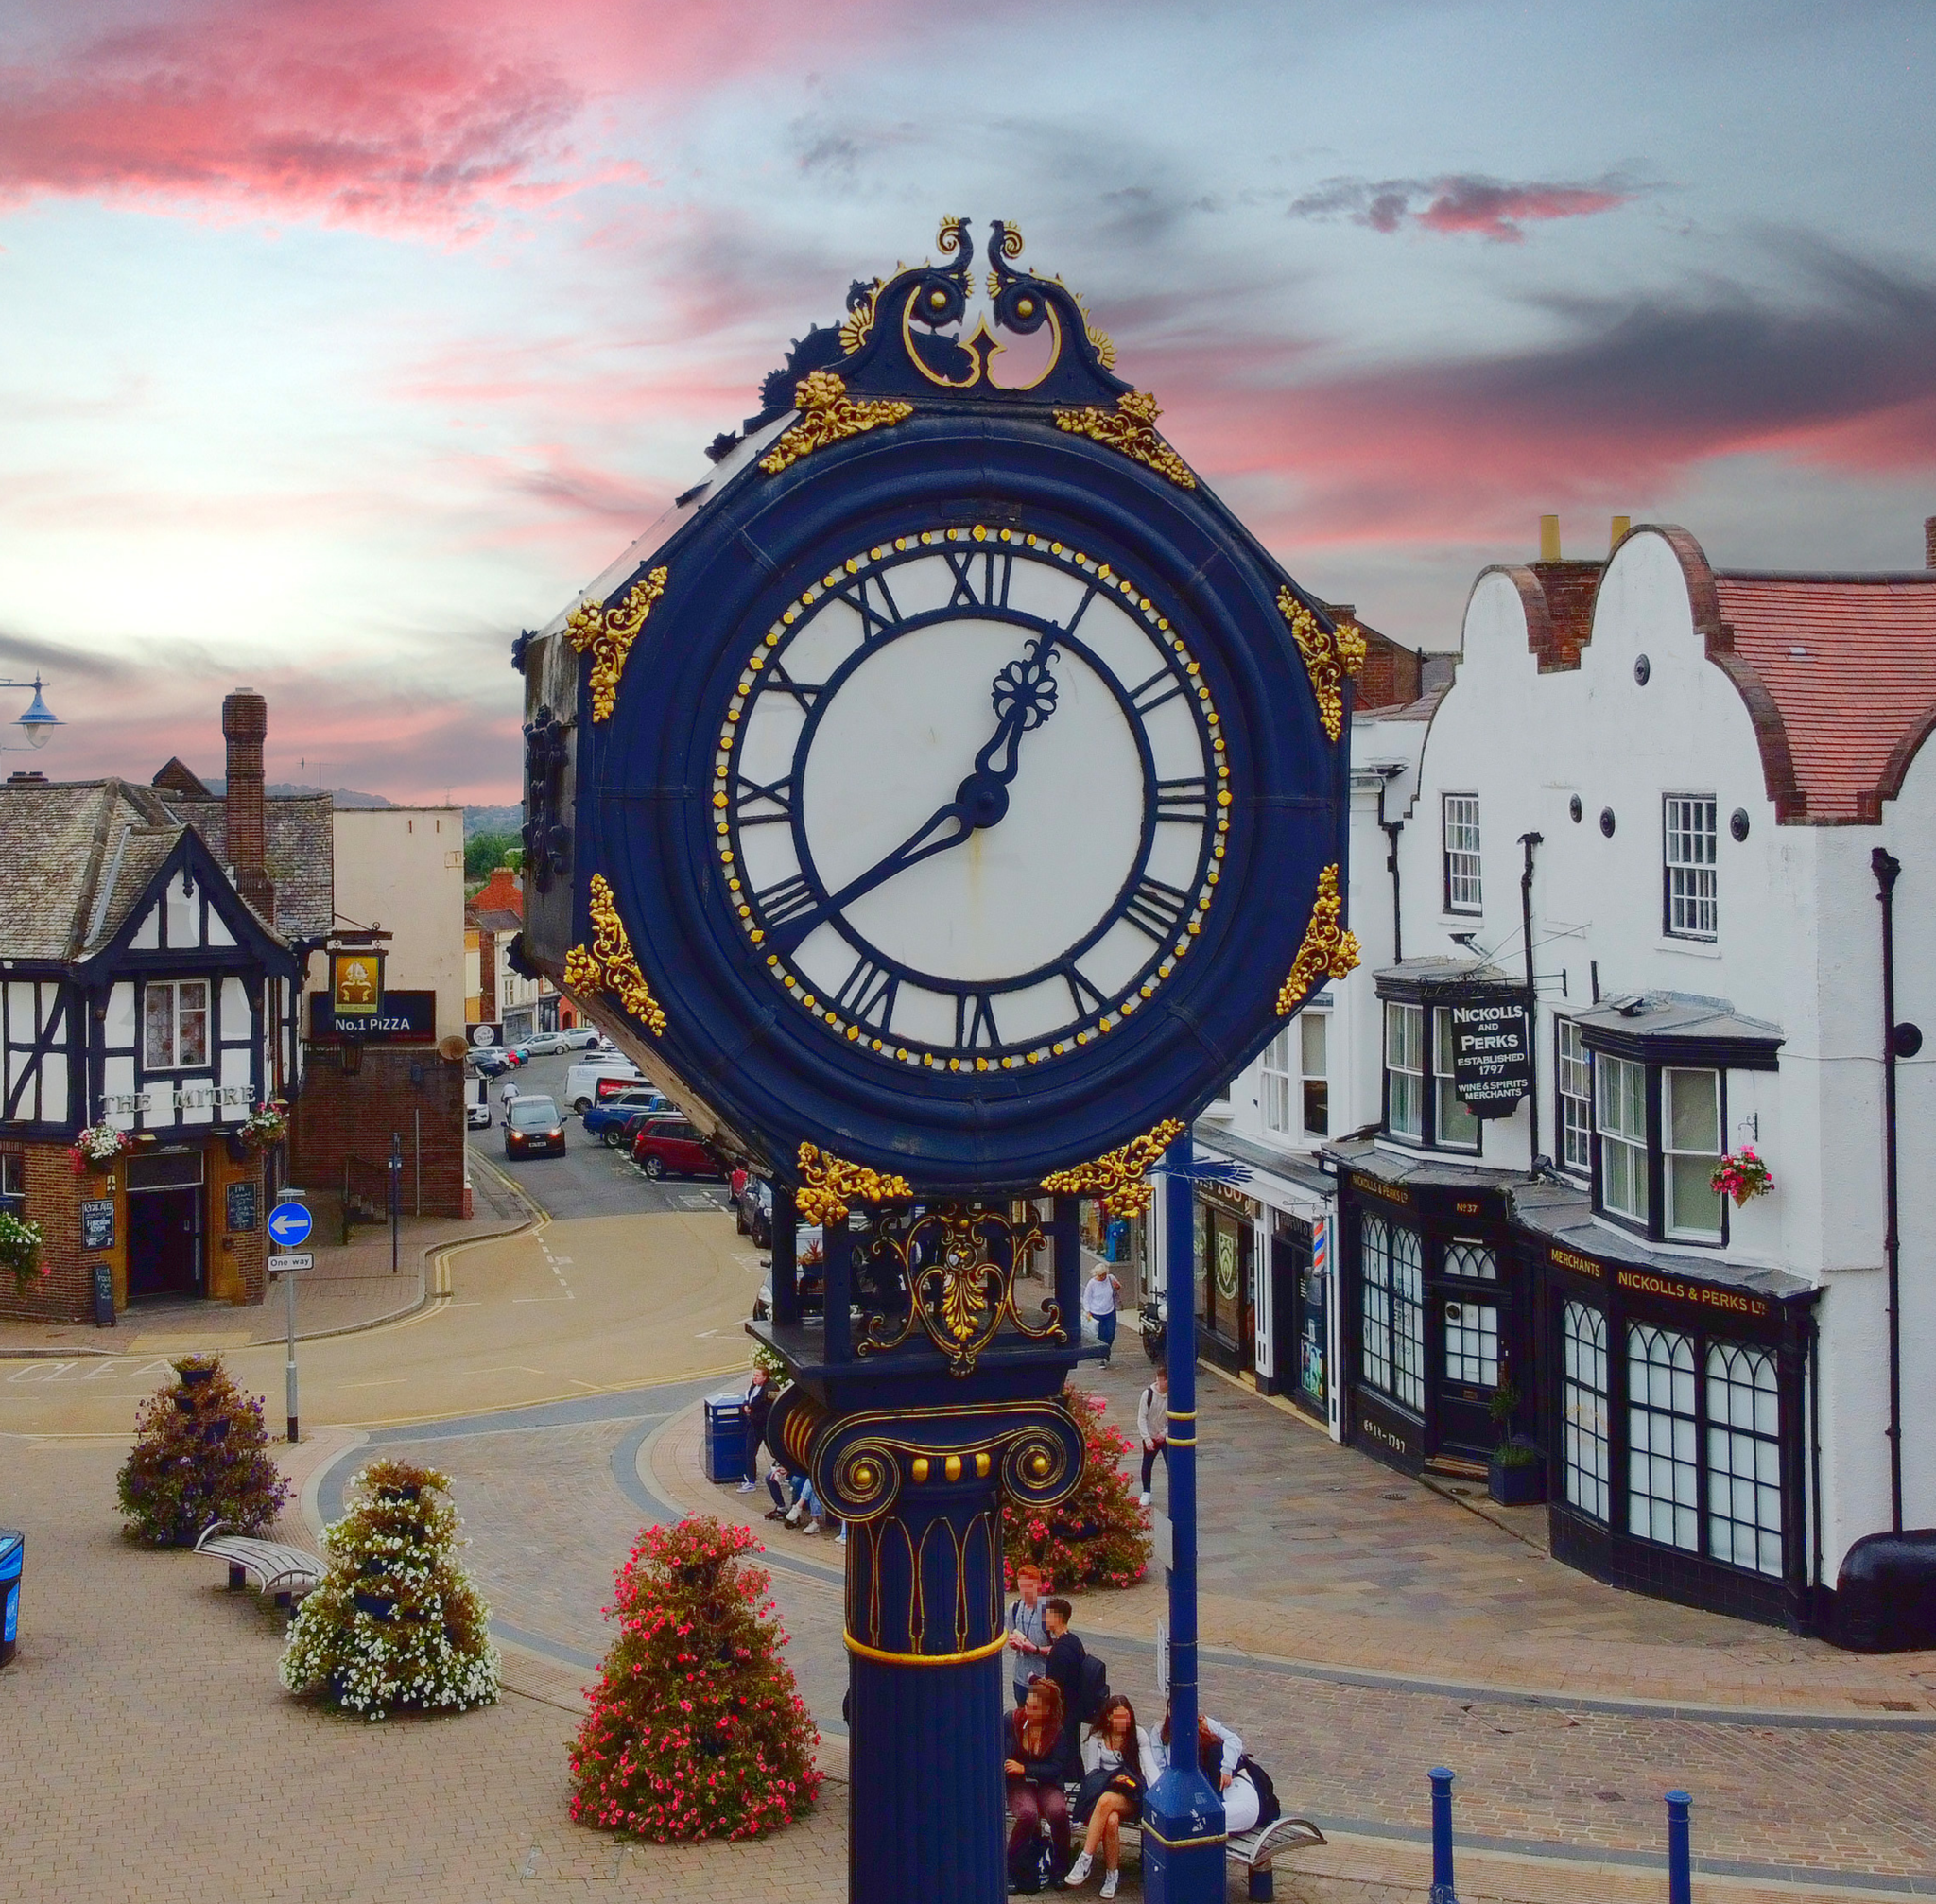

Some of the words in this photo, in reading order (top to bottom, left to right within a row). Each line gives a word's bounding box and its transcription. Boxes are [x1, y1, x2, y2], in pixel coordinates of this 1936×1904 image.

[1452, 1005, 1524, 1023] NICKOLLS
[335, 1018, 366, 1030] No.1
[1478, 1023, 1499, 1031] AND
[1461, 1034, 1519, 1051] PERKS
[1457, 1053, 1525, 1066] ESTABLISHED
[1479, 1064, 1505, 1076] 1797
[1458, 1082, 1482, 1092] WINE
[1482, 1082, 1490, 1090] &
[1490, 1078, 1528, 1090] SPIRITS
[98, 1092, 151, 1115] THE
[173, 1084, 256, 1109] MITRE
[1464, 1087, 1522, 1100] MERCHANTS
[270, 1258, 288, 1267] One
[1551, 1248, 1600, 1277] MERCHANTS
[1618, 1271, 1685, 1298] NICKOLLS
[1688, 1287, 1698, 1301] &
[1702, 1289, 1747, 1311] PERKS
[7, 1360, 183, 1383] CLEA
